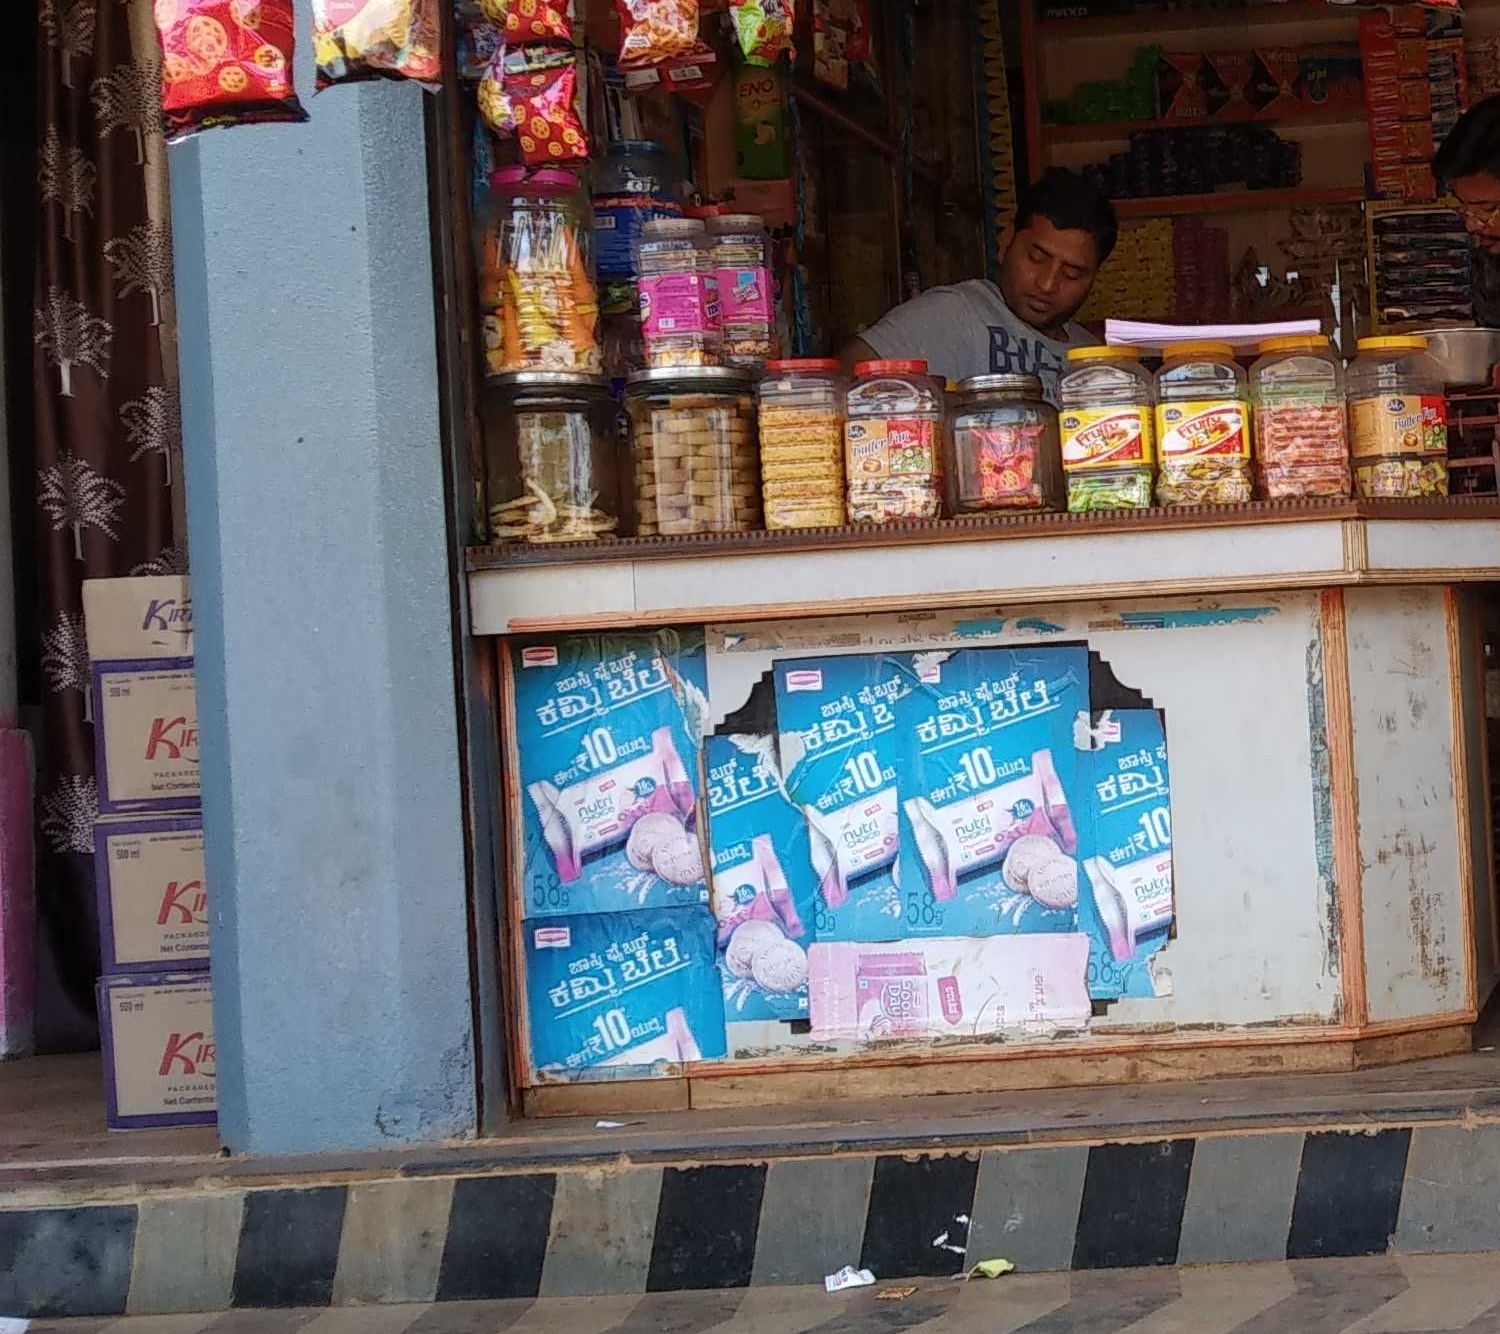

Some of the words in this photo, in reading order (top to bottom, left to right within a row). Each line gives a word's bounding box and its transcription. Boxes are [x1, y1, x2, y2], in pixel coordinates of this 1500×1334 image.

[740, 78, 774, 99] ENO
[578, 796, 615, 818] nutri
[843, 818, 879, 842] nutri
[956, 813, 991, 839] nutri
